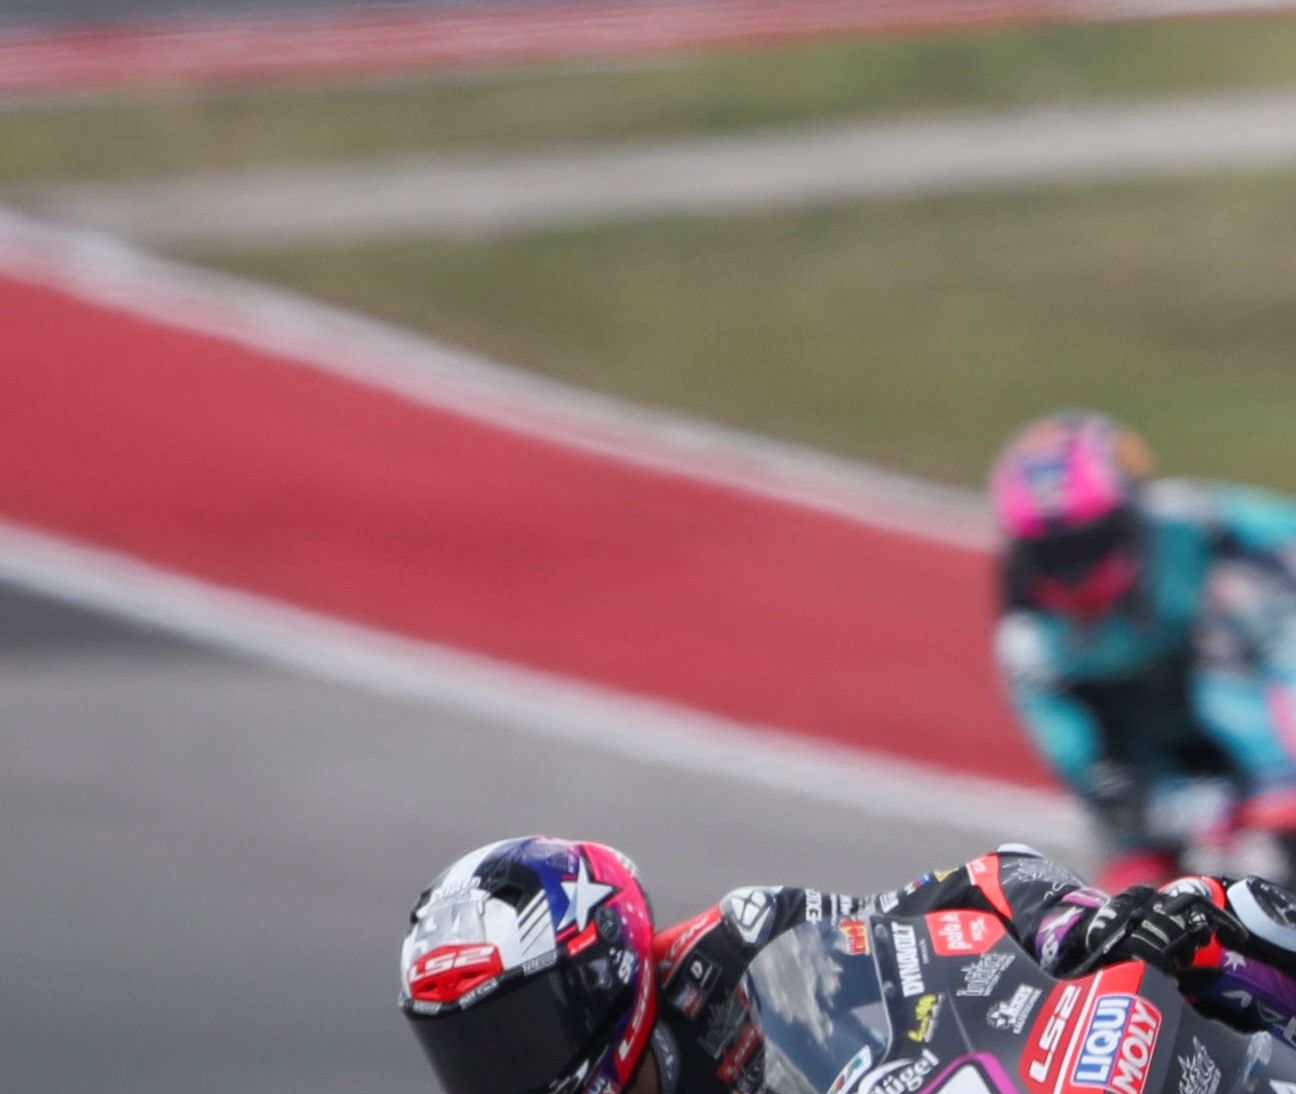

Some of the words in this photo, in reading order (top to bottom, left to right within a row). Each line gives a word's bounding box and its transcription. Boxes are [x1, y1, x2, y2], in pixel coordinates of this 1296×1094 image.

[409, 945, 497, 981] LS2
[891, 921, 925, 997] DYNAVOLT
[1029, 985, 1081, 1083] LS2
[1075, 997, 1131, 1083] LIQUI
